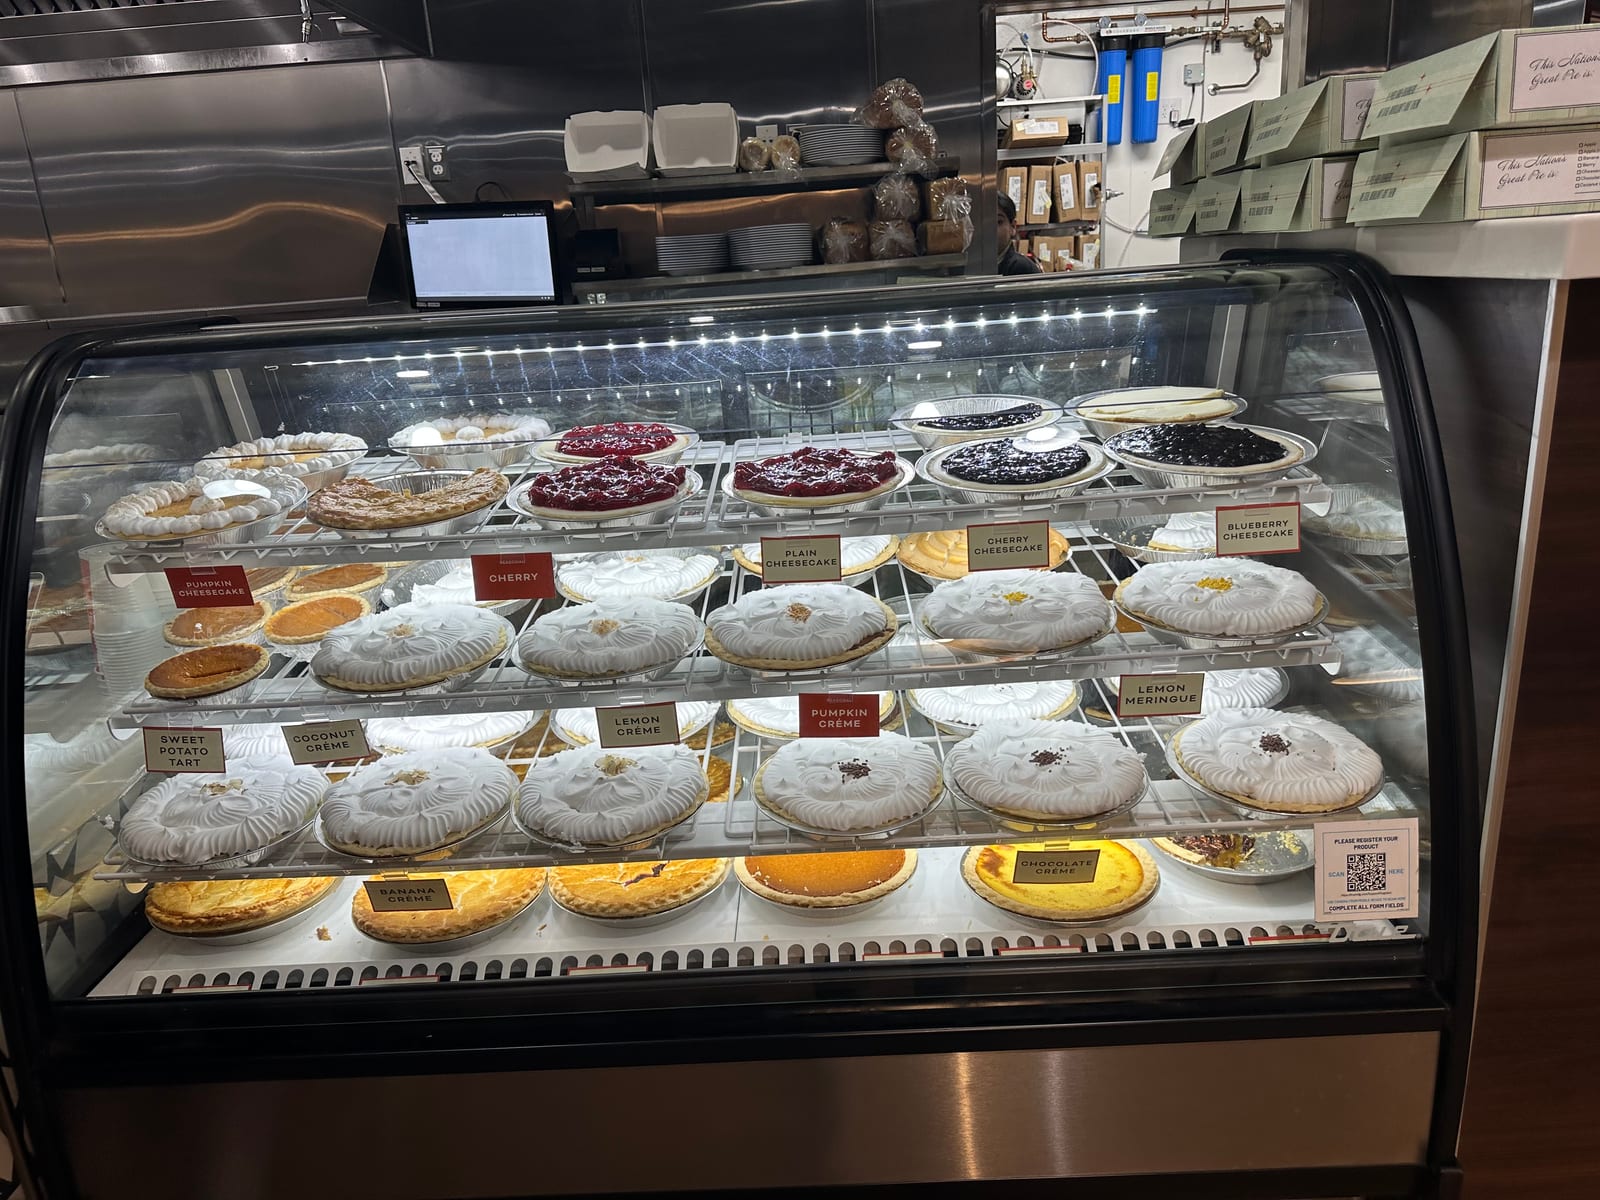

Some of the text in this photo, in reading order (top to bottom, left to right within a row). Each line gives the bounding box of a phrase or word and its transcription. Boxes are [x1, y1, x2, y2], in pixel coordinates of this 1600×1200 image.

[1529, 58, 1554, 72] This
[1528, 73, 1560, 91] Great
[1562, 68, 1580, 81] Pie
[1497, 159, 1522, 172] This
[1497, 173, 1526, 190] Great
[1528, 169, 1546, 182] Pie
[1228, 520, 1289, 531] BLUEBERRY
[1223, 529, 1293, 540] CHEESECAKE
[987, 536, 1029, 545] CHERRY
[974, 544, 1043, 555] CHEESECAKE
[766, 559, 837, 567] CHEESECAKE
[489, 572, 539, 582] CHERRY
[186, 580, 232, 588] PUMPKIN
[179, 588, 245, 597] CHEESECAKE
[1138, 684, 1185, 694] LEMON
[1125, 694, 1197, 705] MERINGUE
[811, 709, 867, 717] PUMPKIN
[615, 715, 660, 725] LEMON
[160, 735, 205, 744] SWEET
[293, 729, 356, 743] COCONUT
[160, 747, 209, 755] POTATO
[168, 758, 201, 767] TART
